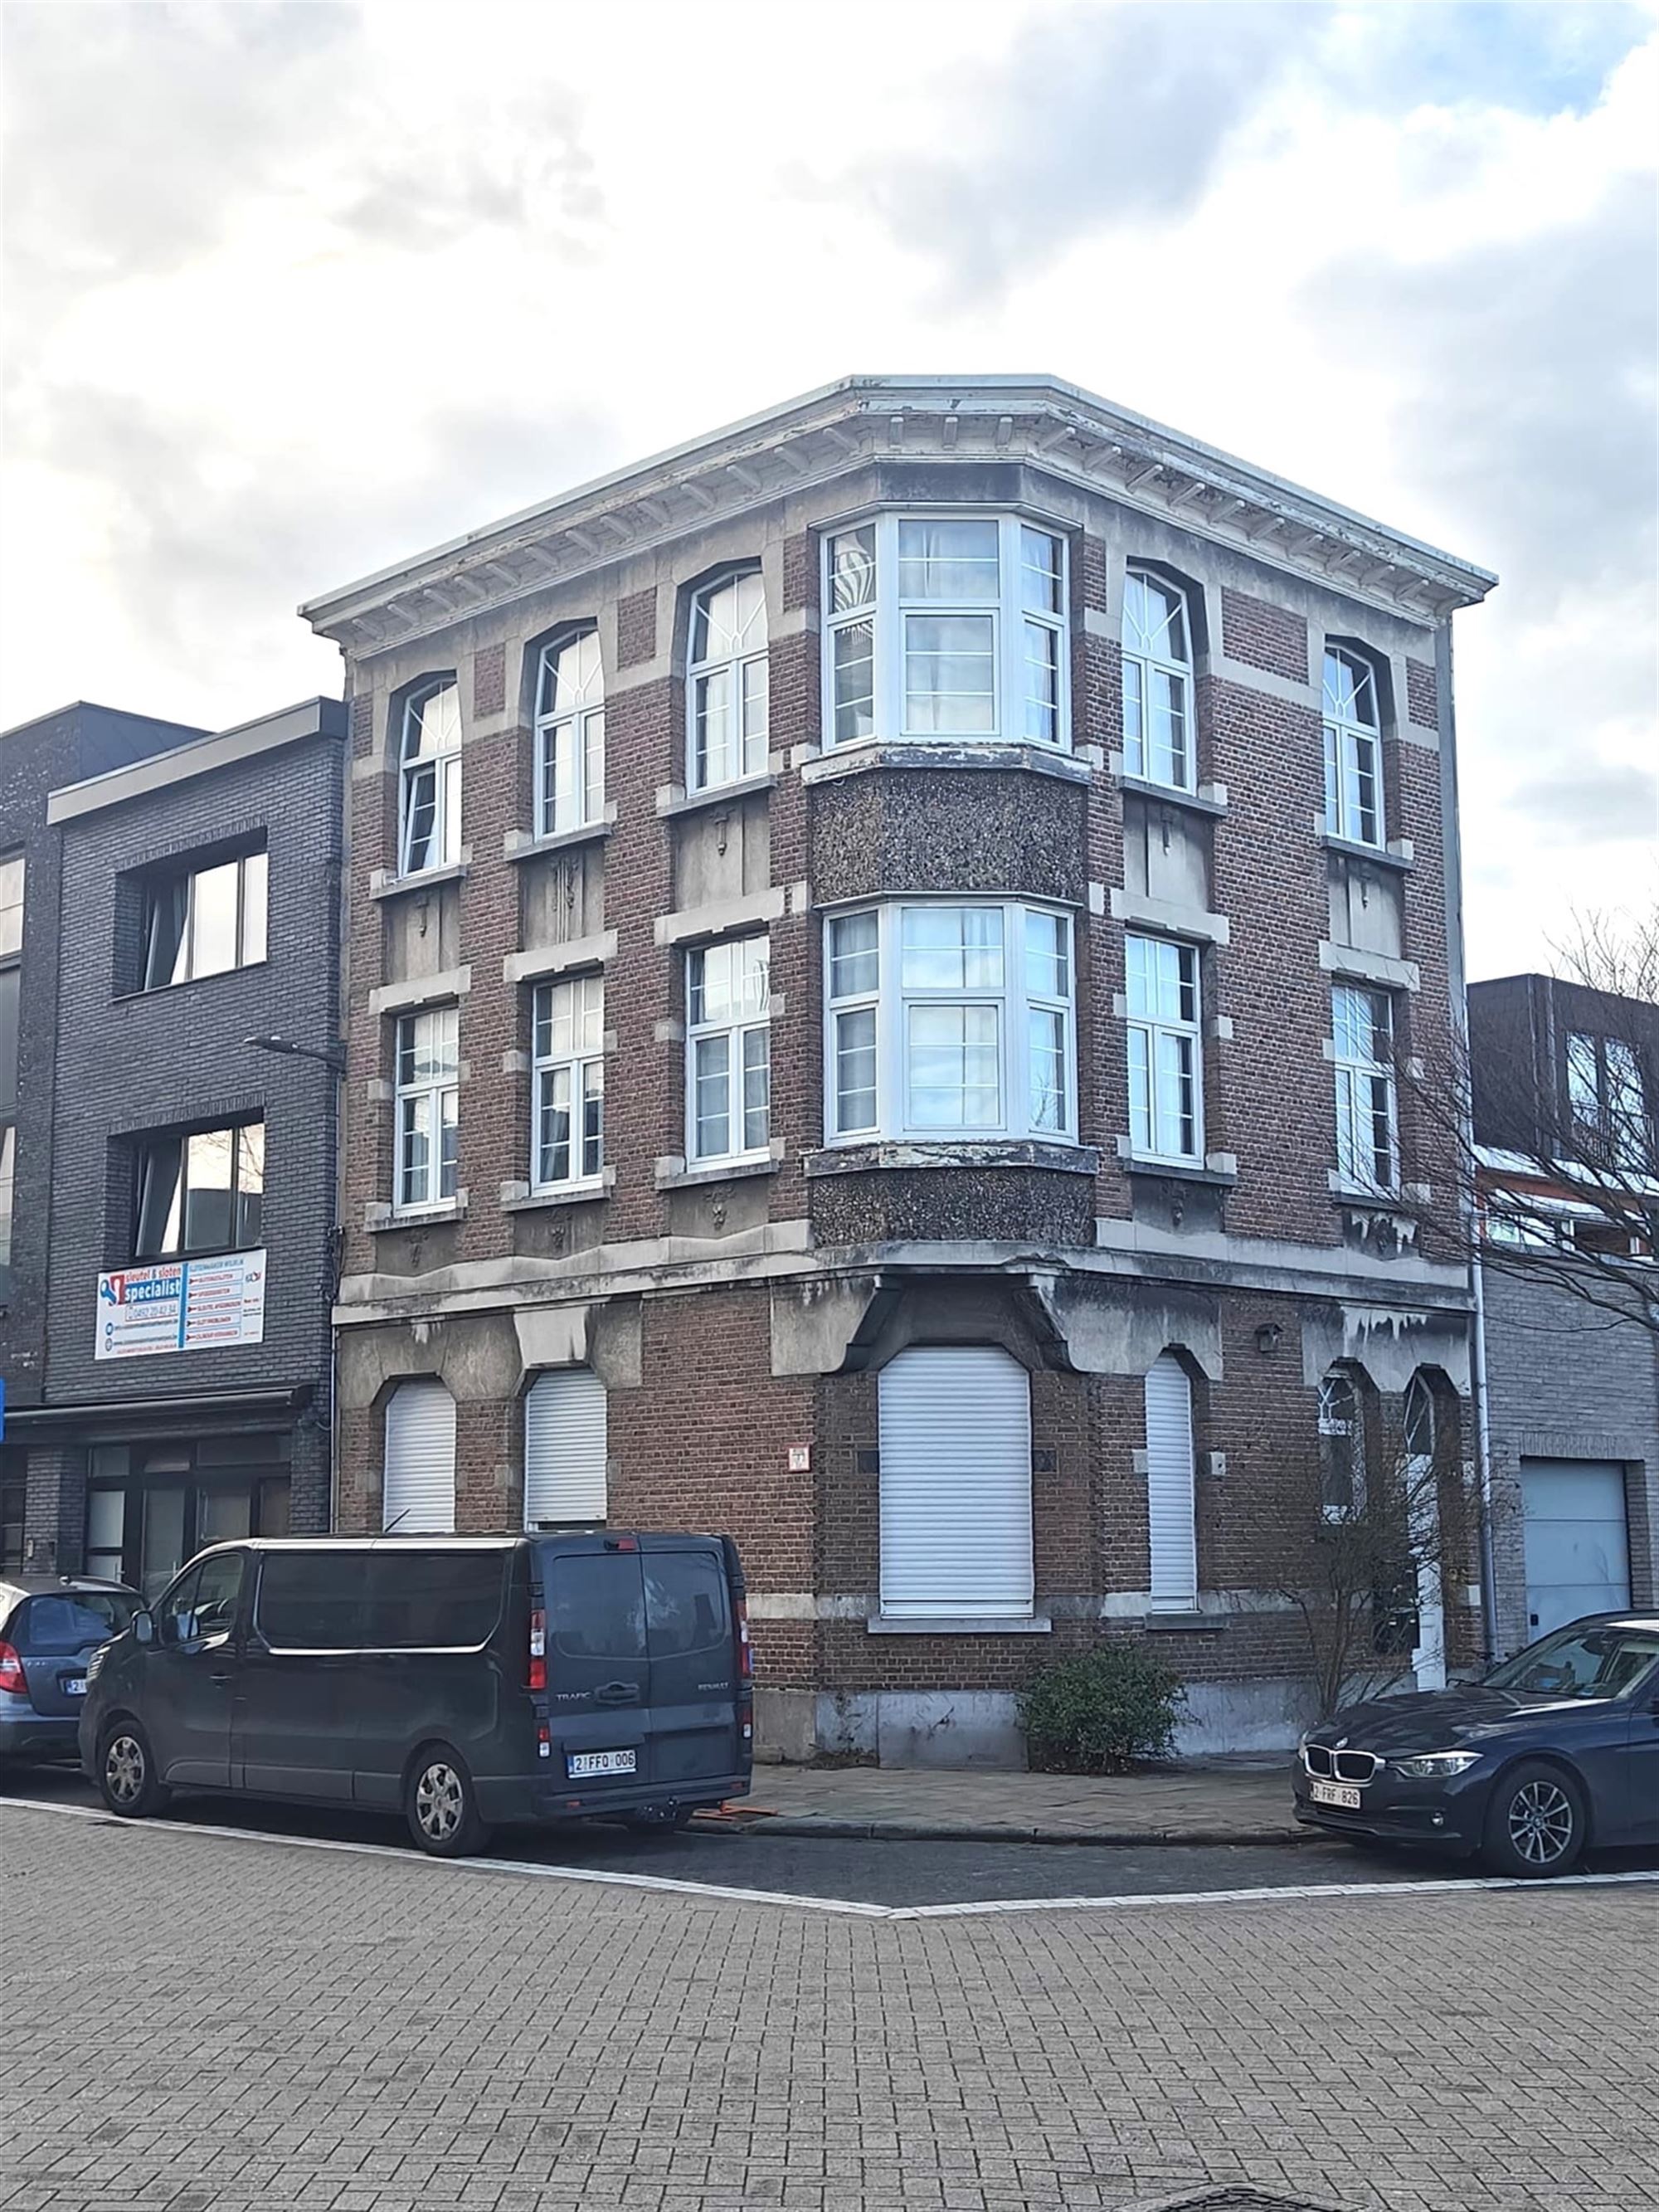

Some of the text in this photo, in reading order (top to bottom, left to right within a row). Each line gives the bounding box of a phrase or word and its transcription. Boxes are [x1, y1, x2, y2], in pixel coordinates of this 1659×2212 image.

[158, 1267, 181, 1279] sloten
[124, 1279, 181, 1303] specialist
[698, 1682, 728, 1691] RENAULT
[557, 1691, 591, 1701] TRAFIC
